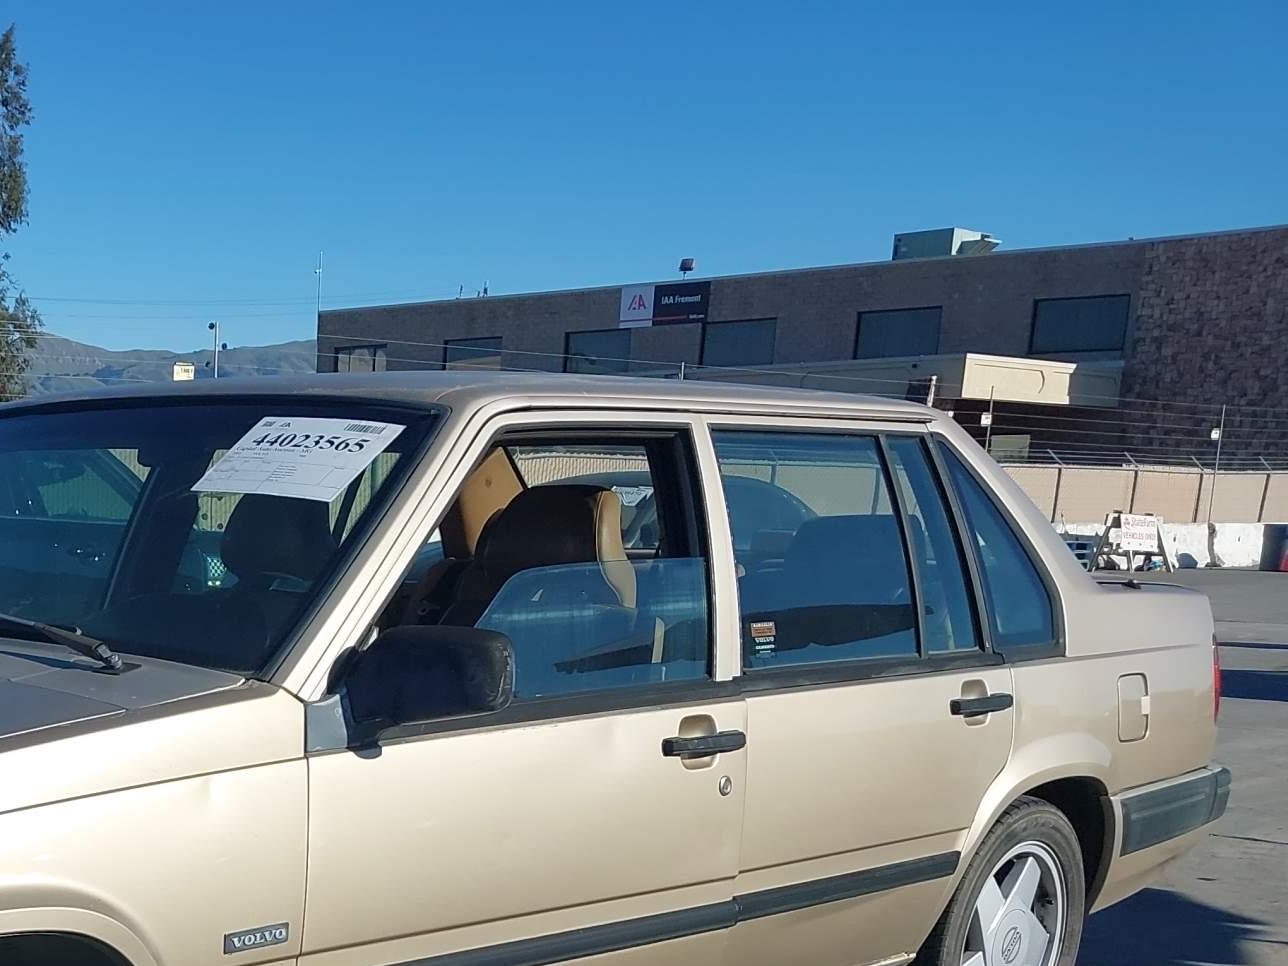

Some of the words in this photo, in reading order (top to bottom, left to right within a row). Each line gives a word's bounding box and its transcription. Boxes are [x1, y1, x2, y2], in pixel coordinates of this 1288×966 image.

[661, 295, 674, 305] IAA
[252, 432, 371, 453] 44023565
[232, 928, 286, 948] VOLVO
